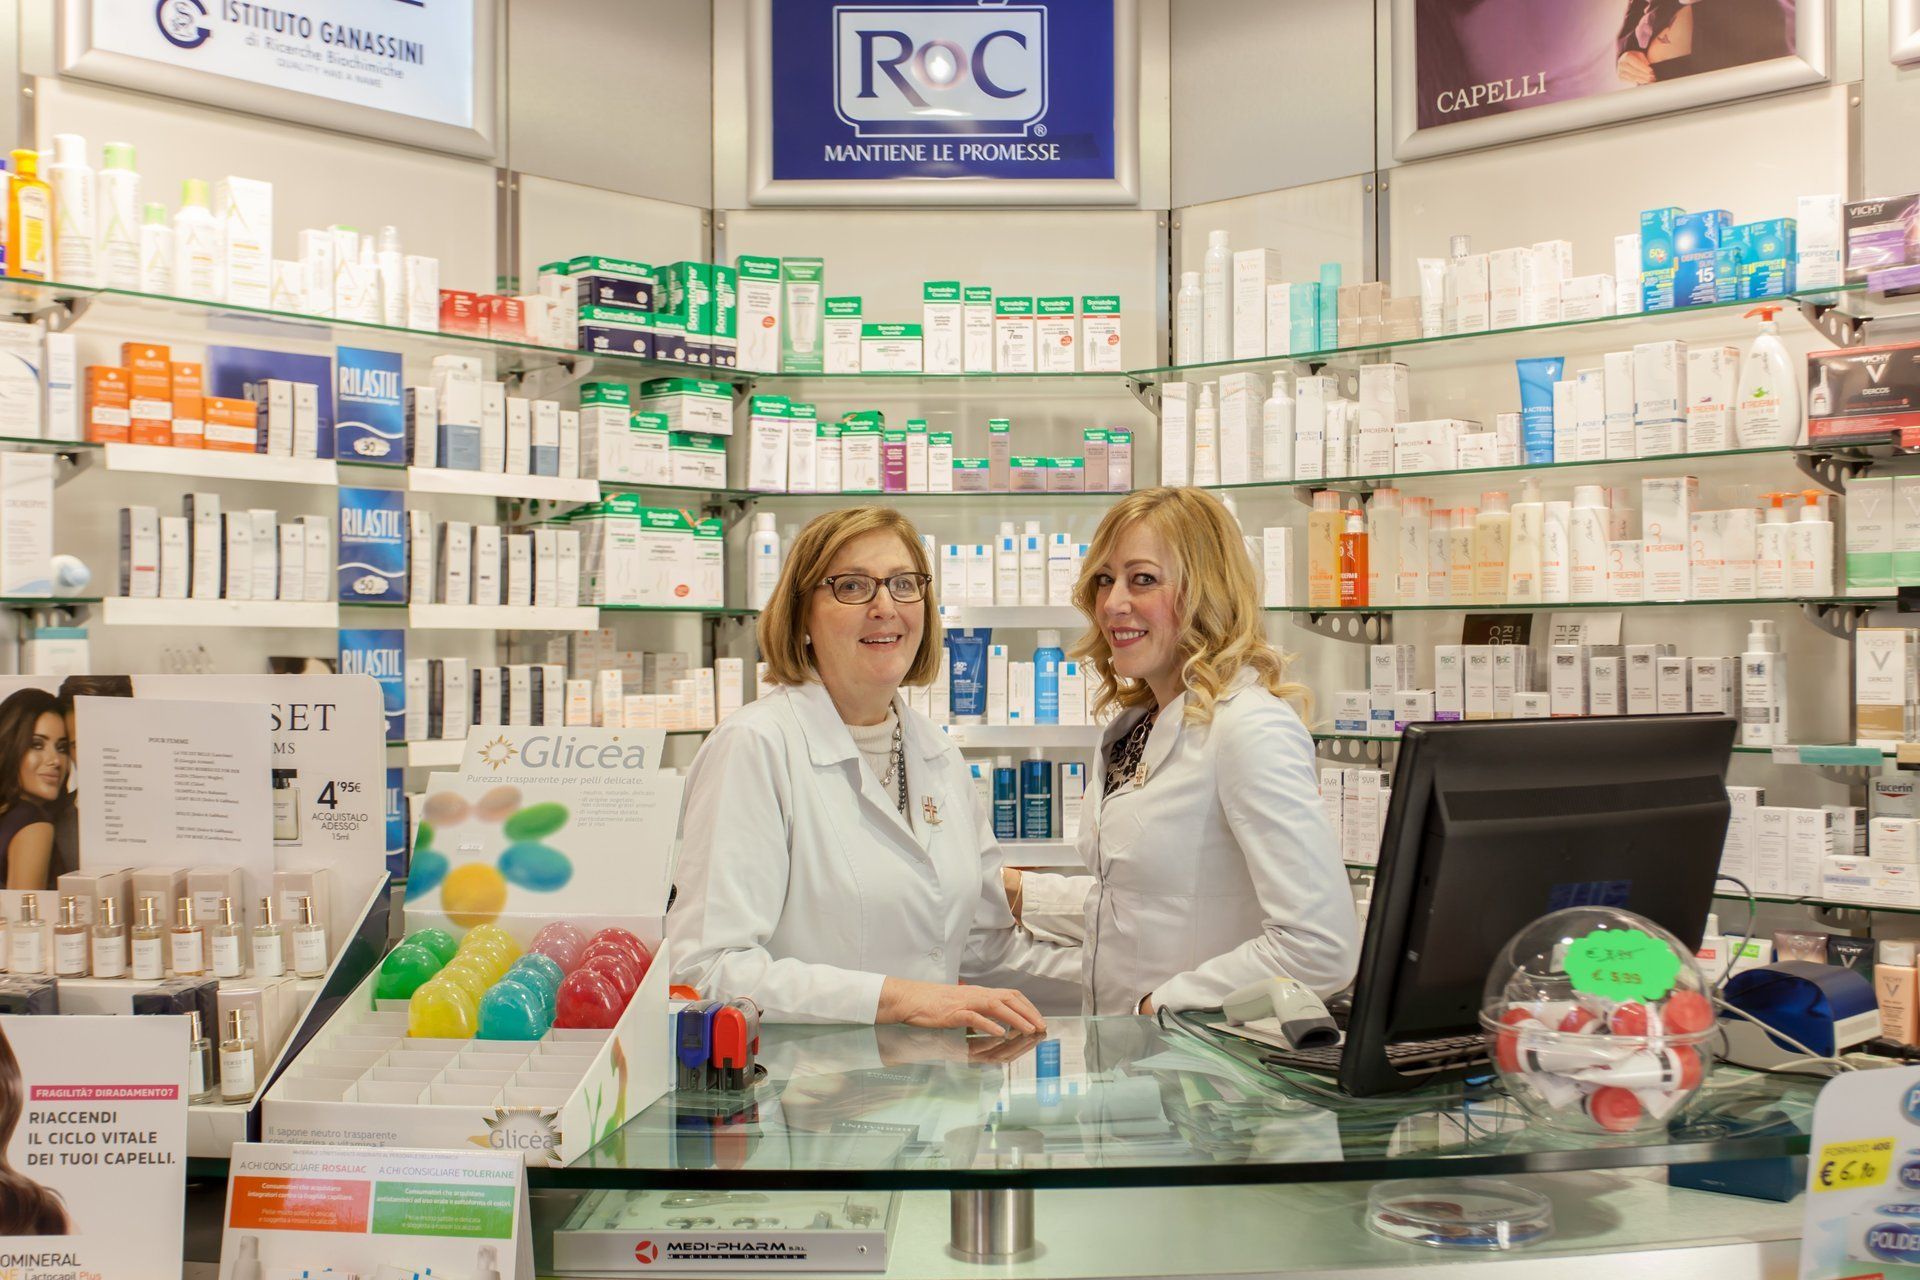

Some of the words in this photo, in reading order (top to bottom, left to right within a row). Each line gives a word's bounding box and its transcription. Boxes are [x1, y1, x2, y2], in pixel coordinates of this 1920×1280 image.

[222, 0, 313, 39] ISTITUTO
[320, 22, 425, 65] GANASSINI
[265, 36, 322, 61] Ricerche
[327, 51, 405, 79] Biochimiche
[1436, 72, 1546, 114] CAPELLI
[824, 144, 927, 162] MANTIENE
[932, 144, 953, 161] LE
[959, 143, 1061, 162] PROMESSE
[1850, 203, 1885, 217] VICHY
[1695, 267, 1714, 283] 15
[339, 365, 401, 400] RILASTIL
[1862, 387, 1890, 396] DERCOS
[341, 506, 402, 538] RILASTIL
[341, 648, 402, 677] RILASTIL
[466, 774, 503, 784] Purezza
[506, 775, 559, 785] trasparente
[561, 776, 577, 785] per
[580, 775, 602, 786] pelli
[604, 775, 644, 785] delicate.
[1875, 781, 1913, 793] Eucerin
[312, 812, 368, 822] ACQUISTALO
[321, 821, 360, 831] ADESSO!
[36, 1088, 93, 1098] FRAGILITÀ?
[95, 1088, 174, 1098] DIRADAMENTO?
[29, 1111, 118, 1124] RIACCENDI
[28, 1132, 42, 1145] IL
[48, 1132, 96, 1145] CICLO
[102, 1131, 158, 1144] VITALE
[276, 1128, 308, 1138] sapone
[310, 1127, 341, 1138] neutro
[344, 1129, 398, 1140] trasparente
[27, 1153, 54, 1166] DEI
[60, 1152, 99, 1165] TUOI
[104, 1152, 176, 1165] CAPELLI.
[247, 1162, 262, 1170] CHI
[263, 1162, 320, 1172] CONSIGLIARE
[322, 1164, 368, 1174] ROSALIAC
[388, 1167, 401, 1175] CHI
[402, 1167, 460, 1178] CONSIGLIARE
[462, 1170, 514, 1180] TOLERIANE
[667, 1242, 786, 1251] MEDI-PHARM
